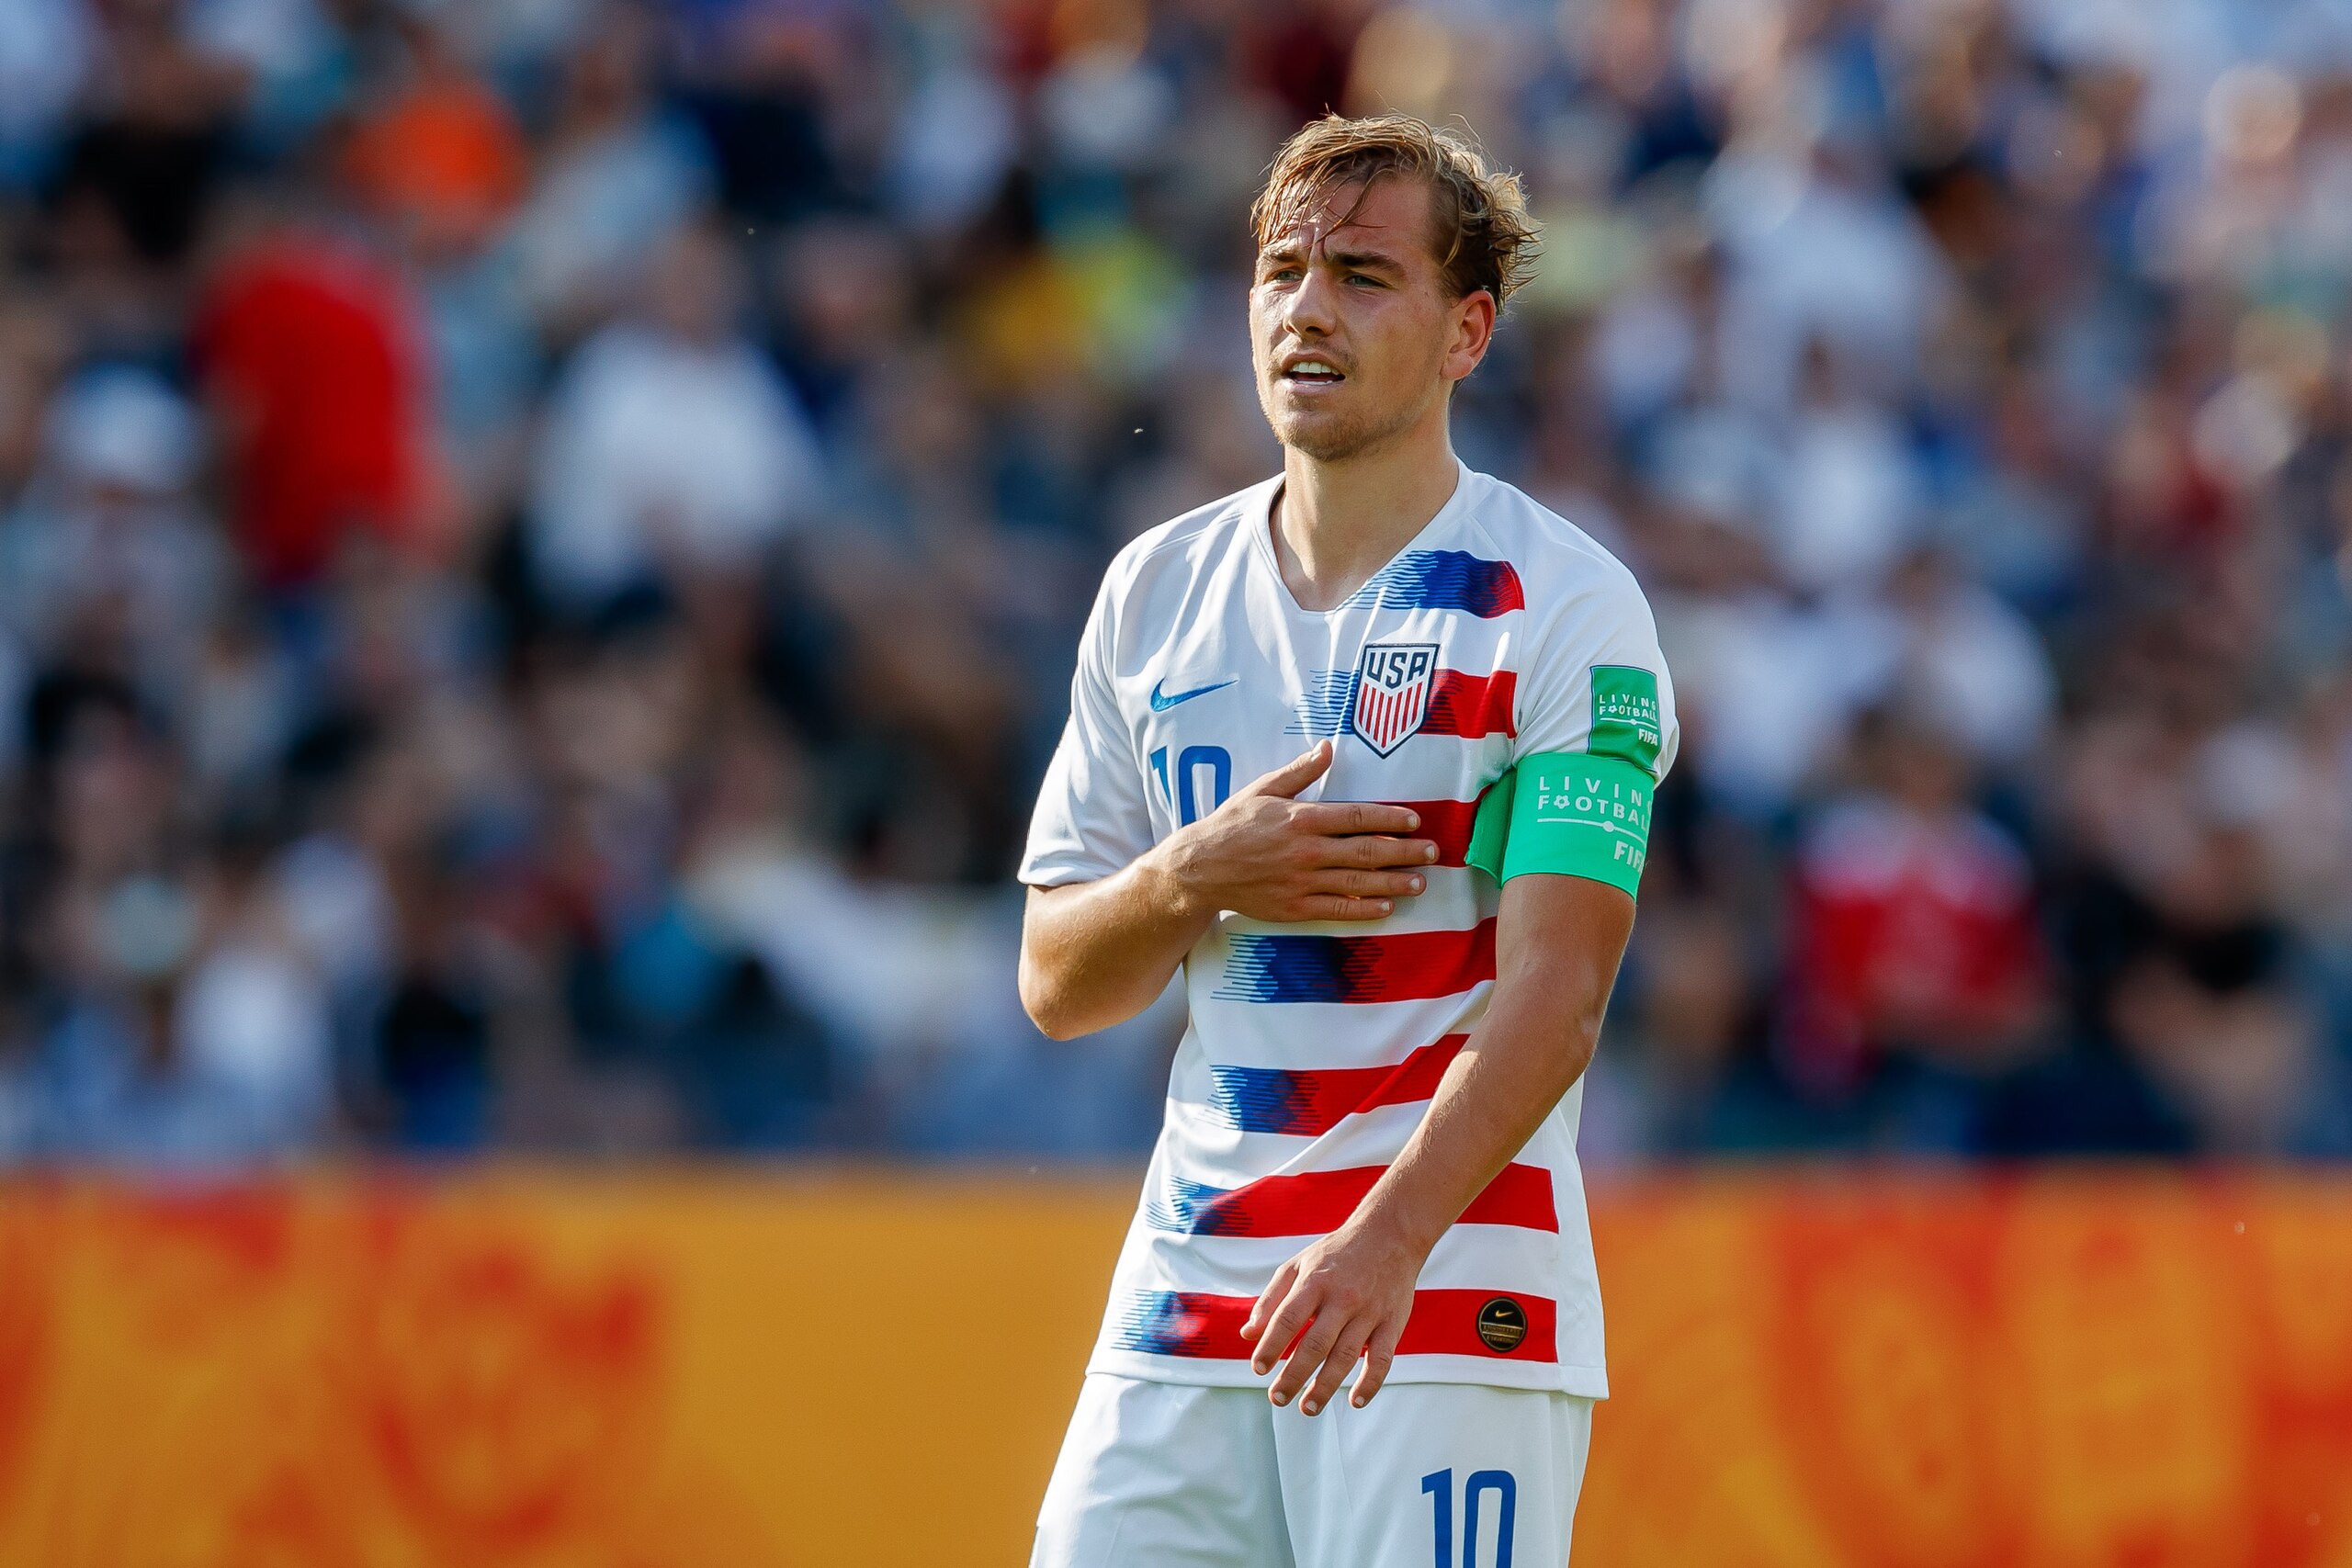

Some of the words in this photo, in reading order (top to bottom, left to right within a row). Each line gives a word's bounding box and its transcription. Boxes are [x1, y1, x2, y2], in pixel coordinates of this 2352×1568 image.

[1367, 652, 1430, 689] USA
[1599, 694, 1656, 710] LIVING
[1638, 728, 1659, 747] FIFA
[1150, 745, 1231, 827] 10
[1537, 795, 1649, 831] FOOTBAL
[1421, 1467, 1516, 1568] 10
